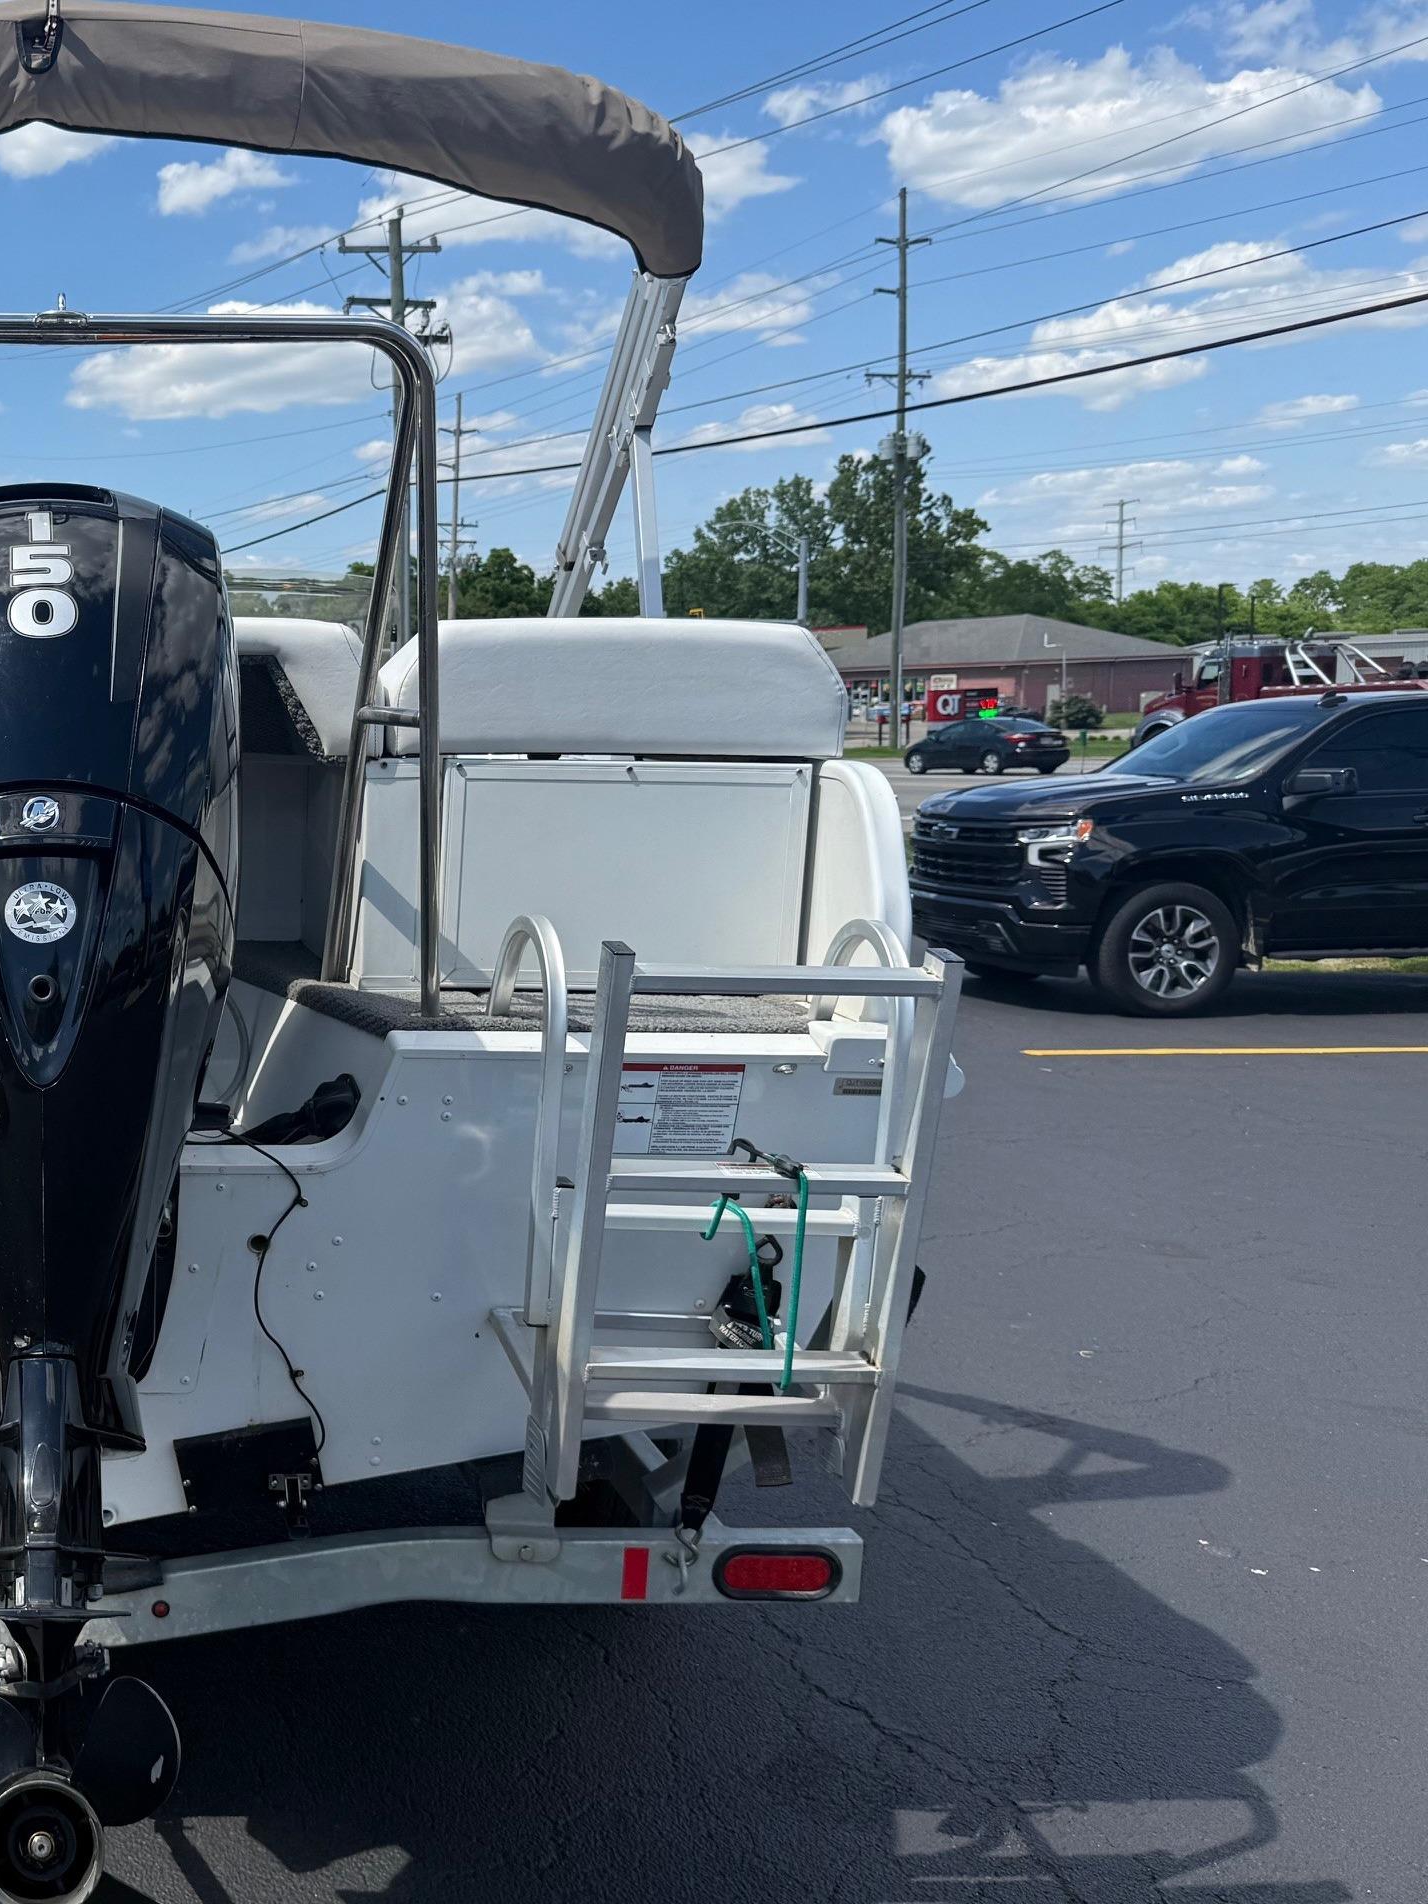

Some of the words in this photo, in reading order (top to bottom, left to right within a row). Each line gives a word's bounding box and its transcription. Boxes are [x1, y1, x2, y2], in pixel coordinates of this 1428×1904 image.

[7, 510, 78, 639] 150
[936, 694, 962, 716] QT
[50, 884, 70, 900] LOW
